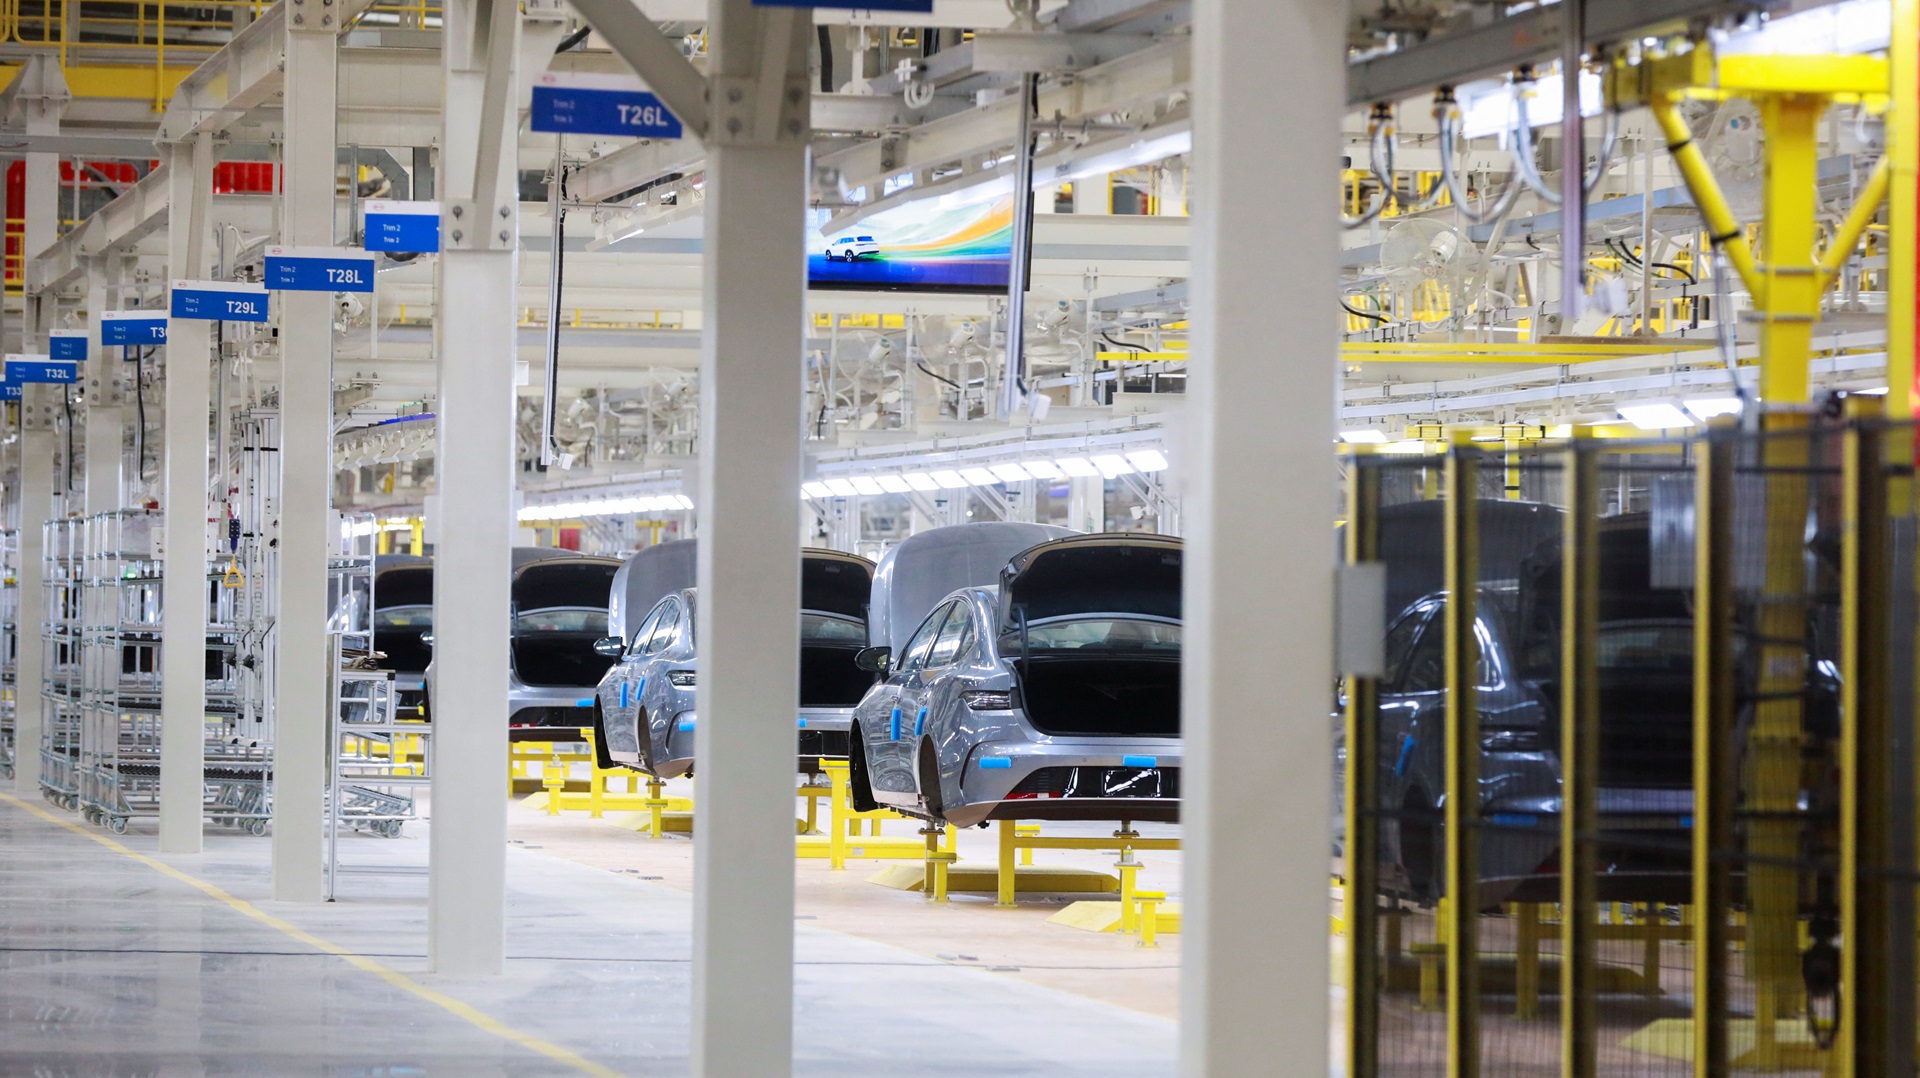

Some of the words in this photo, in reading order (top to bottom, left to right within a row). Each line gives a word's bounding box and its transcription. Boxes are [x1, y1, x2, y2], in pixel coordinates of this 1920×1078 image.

[617, 104, 668, 126] T26L
[396, 224, 401, 232] 2
[326, 268, 364, 284] T28L
[226, 300, 259, 314] T29L
[150, 327, 168, 338] T3
[45, 368, 70, 379] T32L
